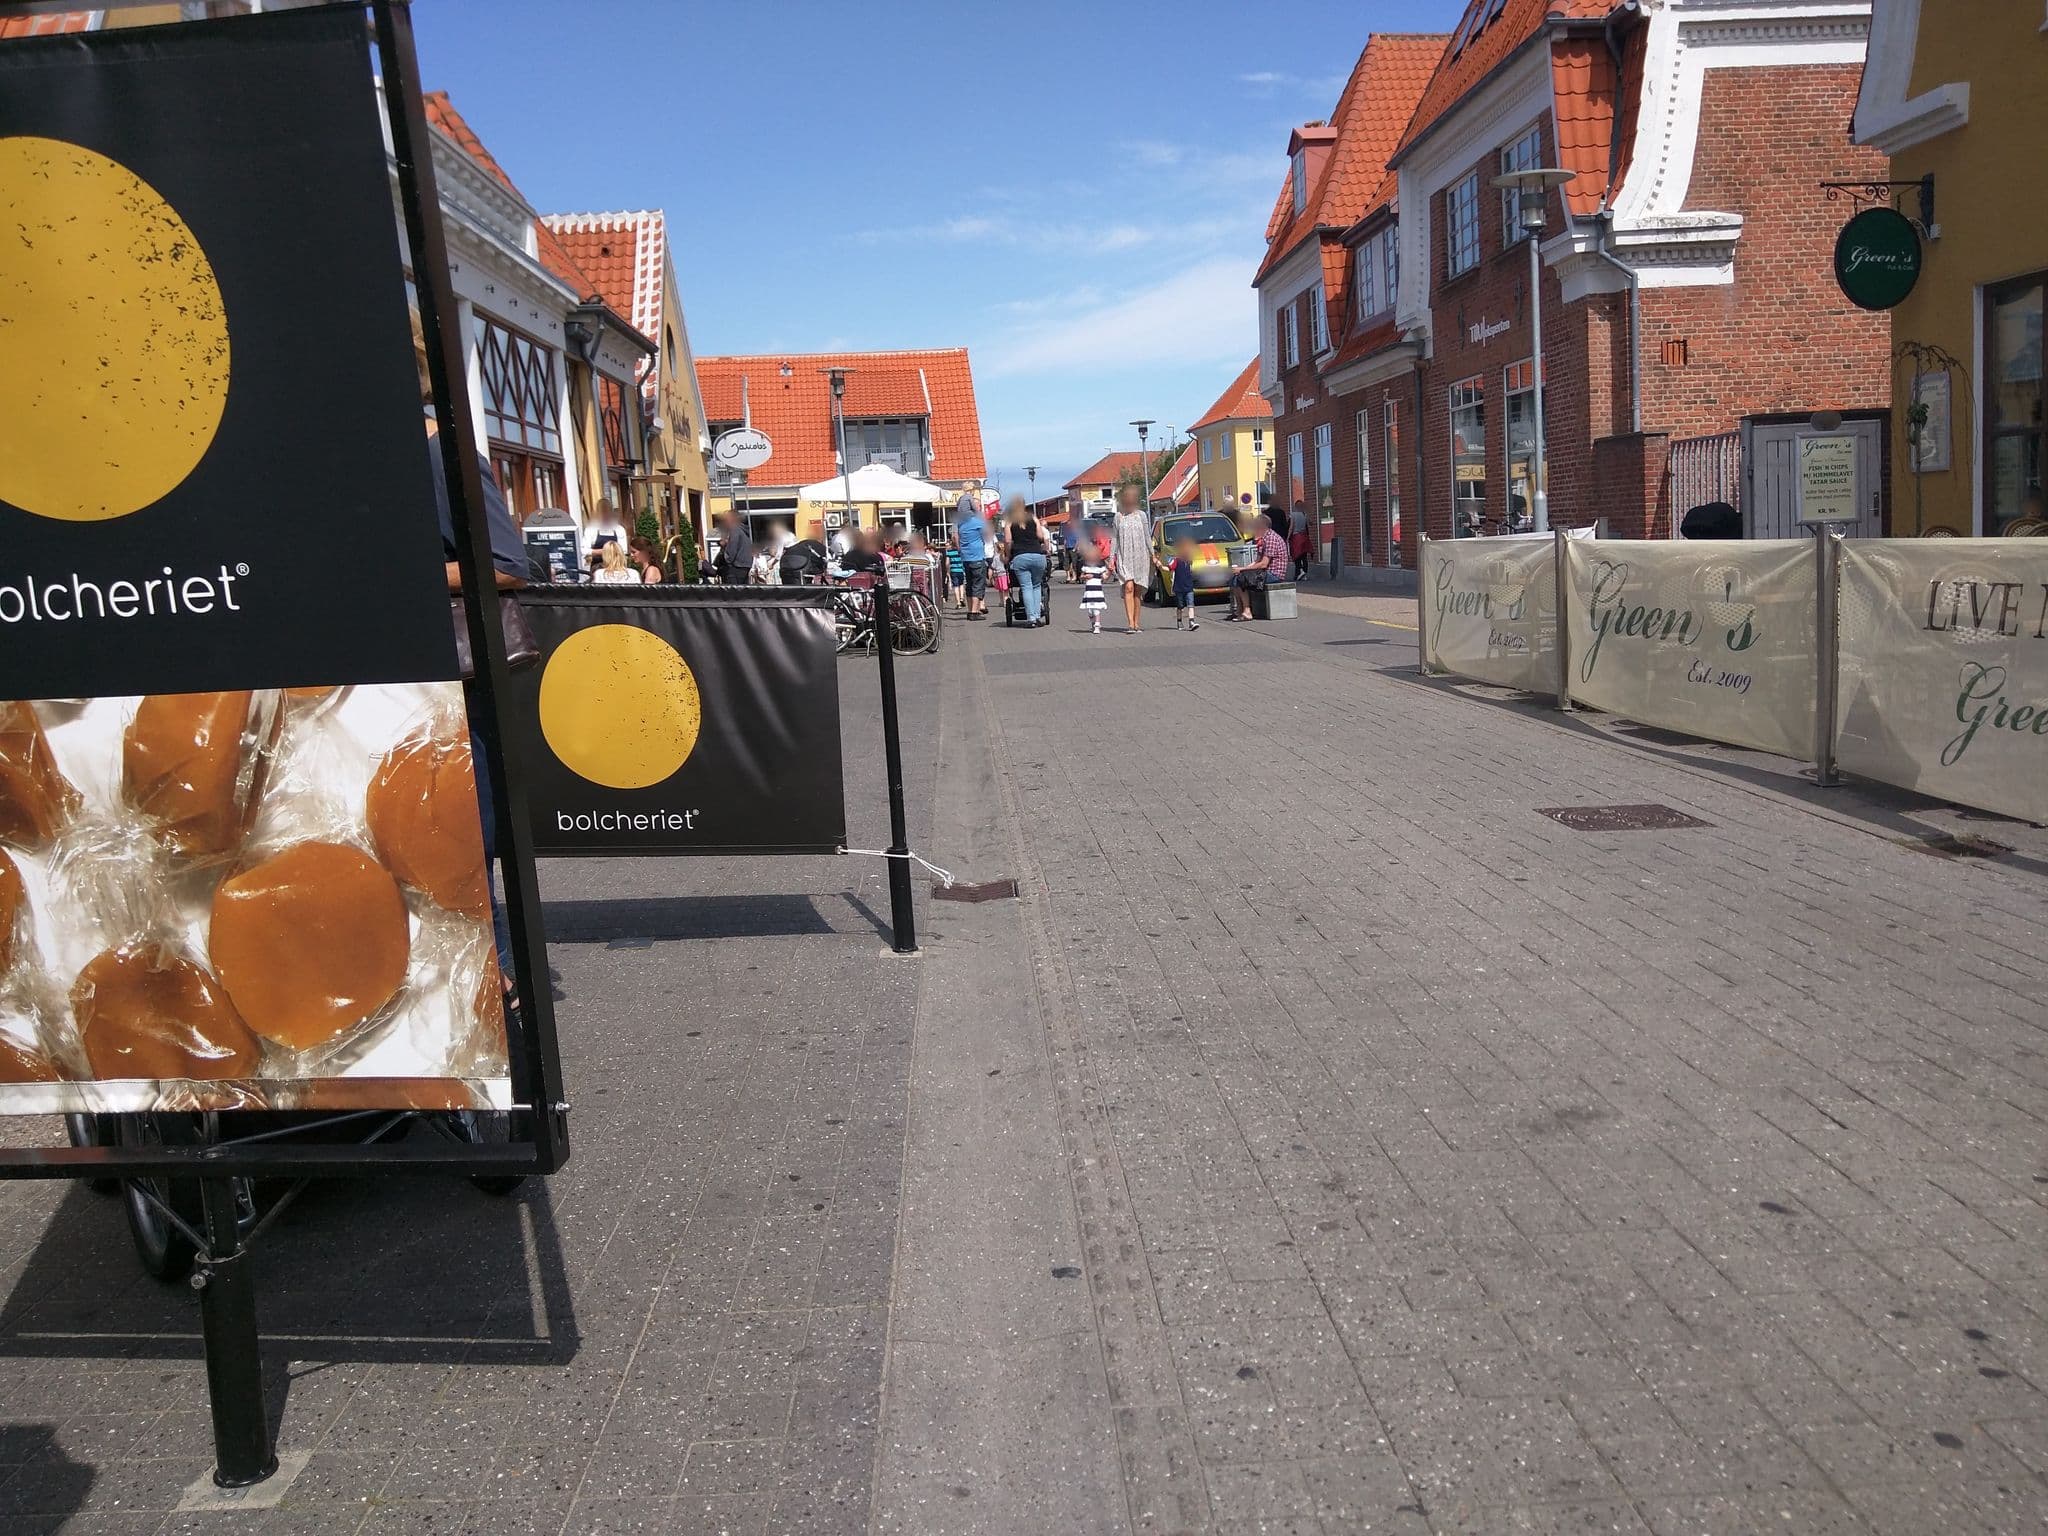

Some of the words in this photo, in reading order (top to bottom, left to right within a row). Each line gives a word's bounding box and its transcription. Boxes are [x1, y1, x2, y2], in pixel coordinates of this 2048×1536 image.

[1845, 245, 1913, 272] Green's
[1802, 439, 1852, 458] Green's
[1431, 558, 1527, 652] Green's
[1581, 560, 1762, 684] Green's
[1923, 580, 2024, 637] LIVE
[1687, 658, 1712, 684] Est.
[1716, 671, 1752, 695] 2009
